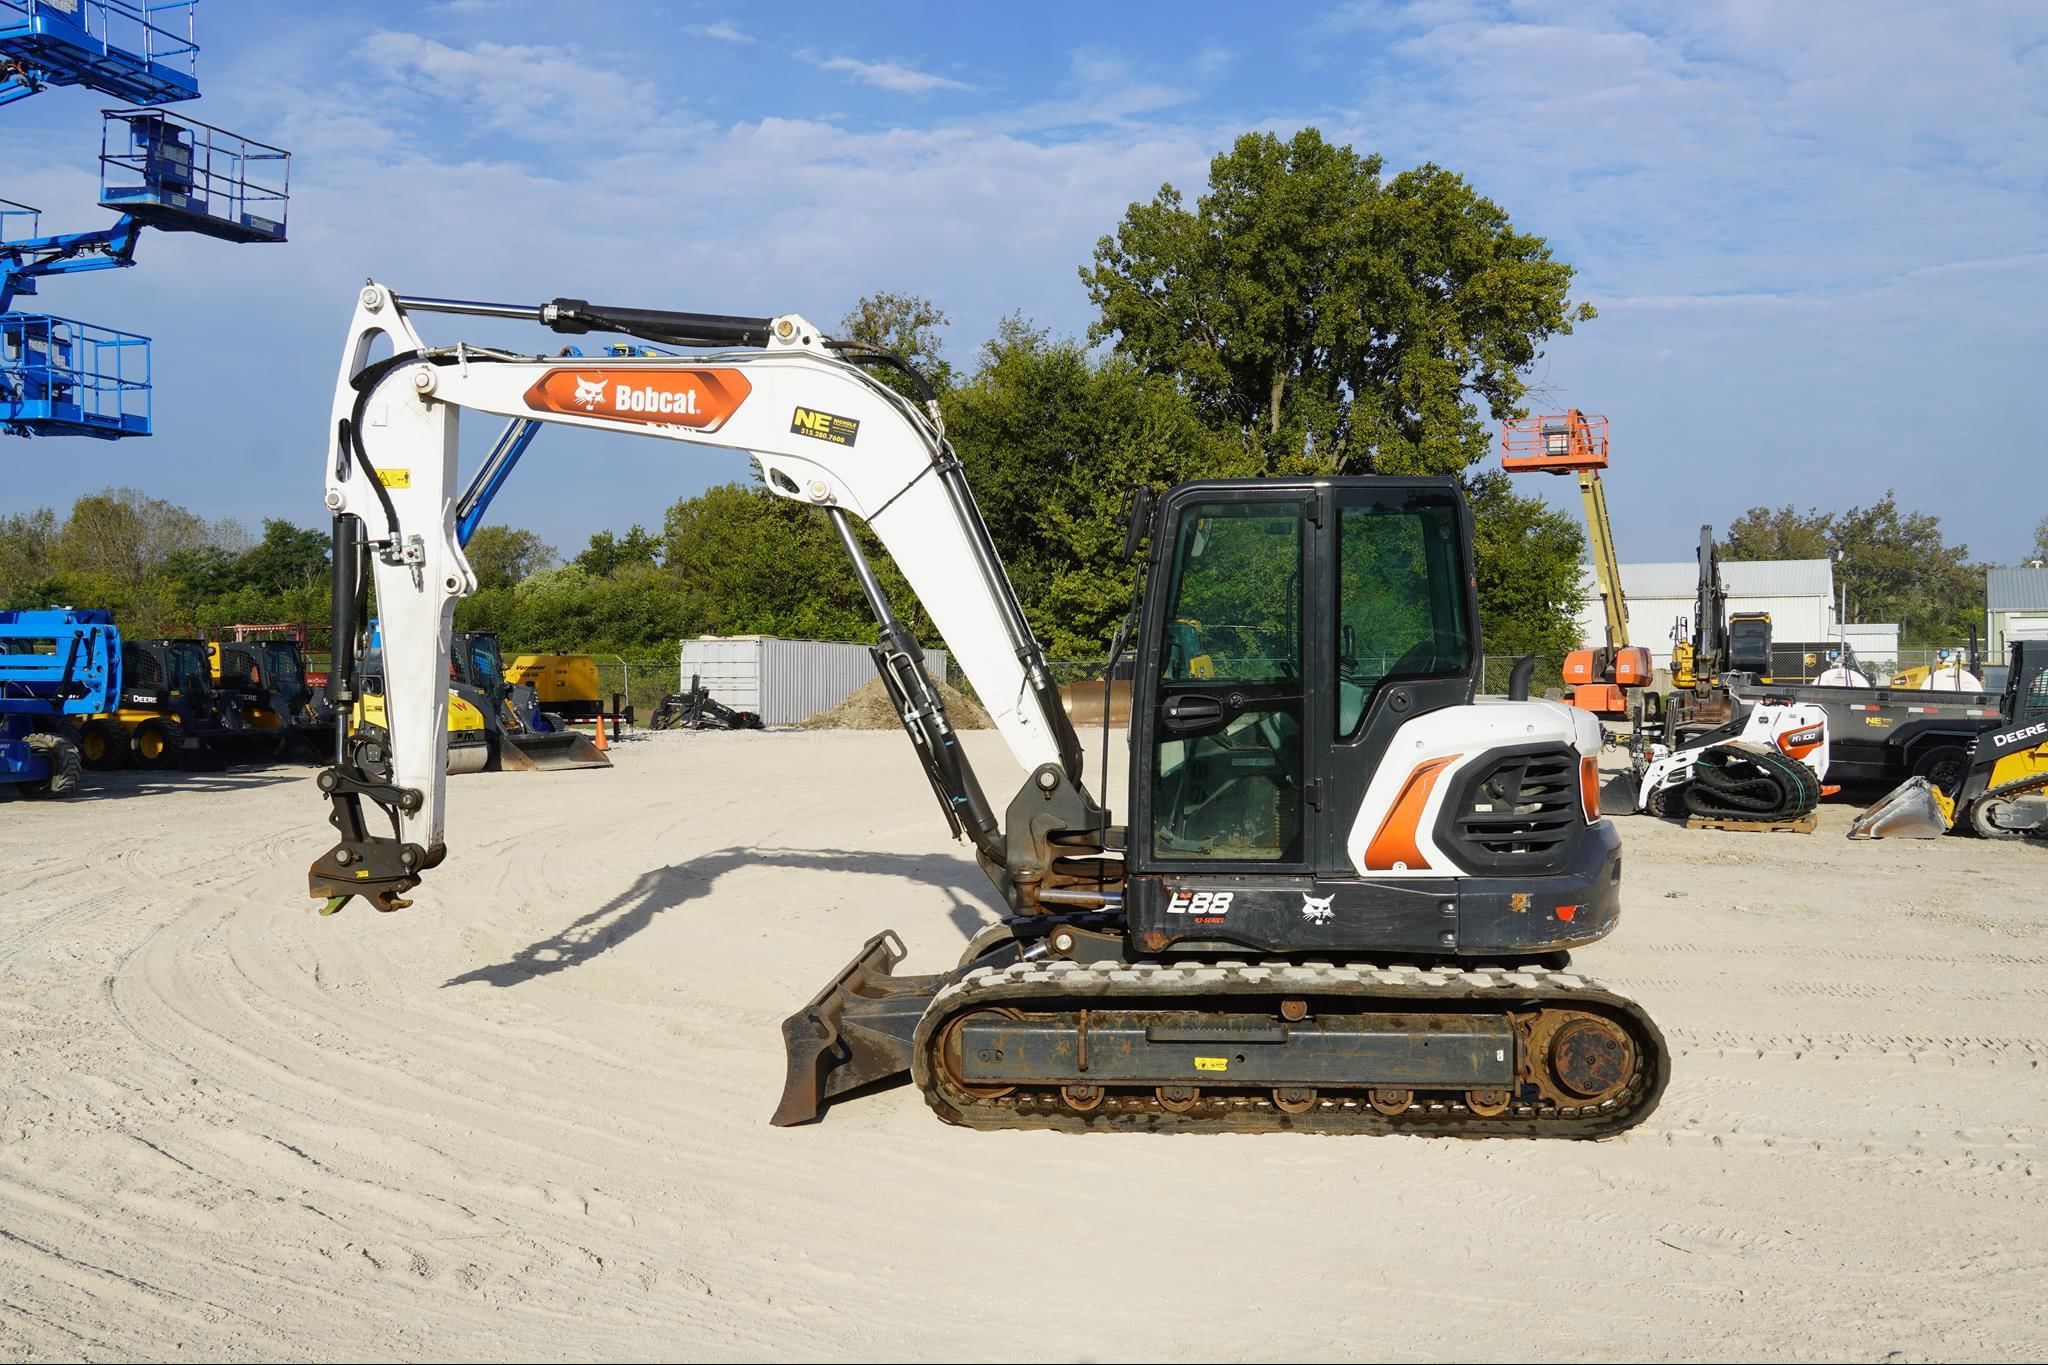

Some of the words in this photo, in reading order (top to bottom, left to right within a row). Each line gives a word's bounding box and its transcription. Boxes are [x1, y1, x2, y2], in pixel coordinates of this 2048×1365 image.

[616, 385, 696, 414] Bobcat
[794, 409, 832, 432] NE
[801, 428, 845, 443] 515.280.7600
[133, 695, 158, 703] DEERE
[1993, 722, 2048, 747] DEERE
[1167, 892, 1234, 914] E88
